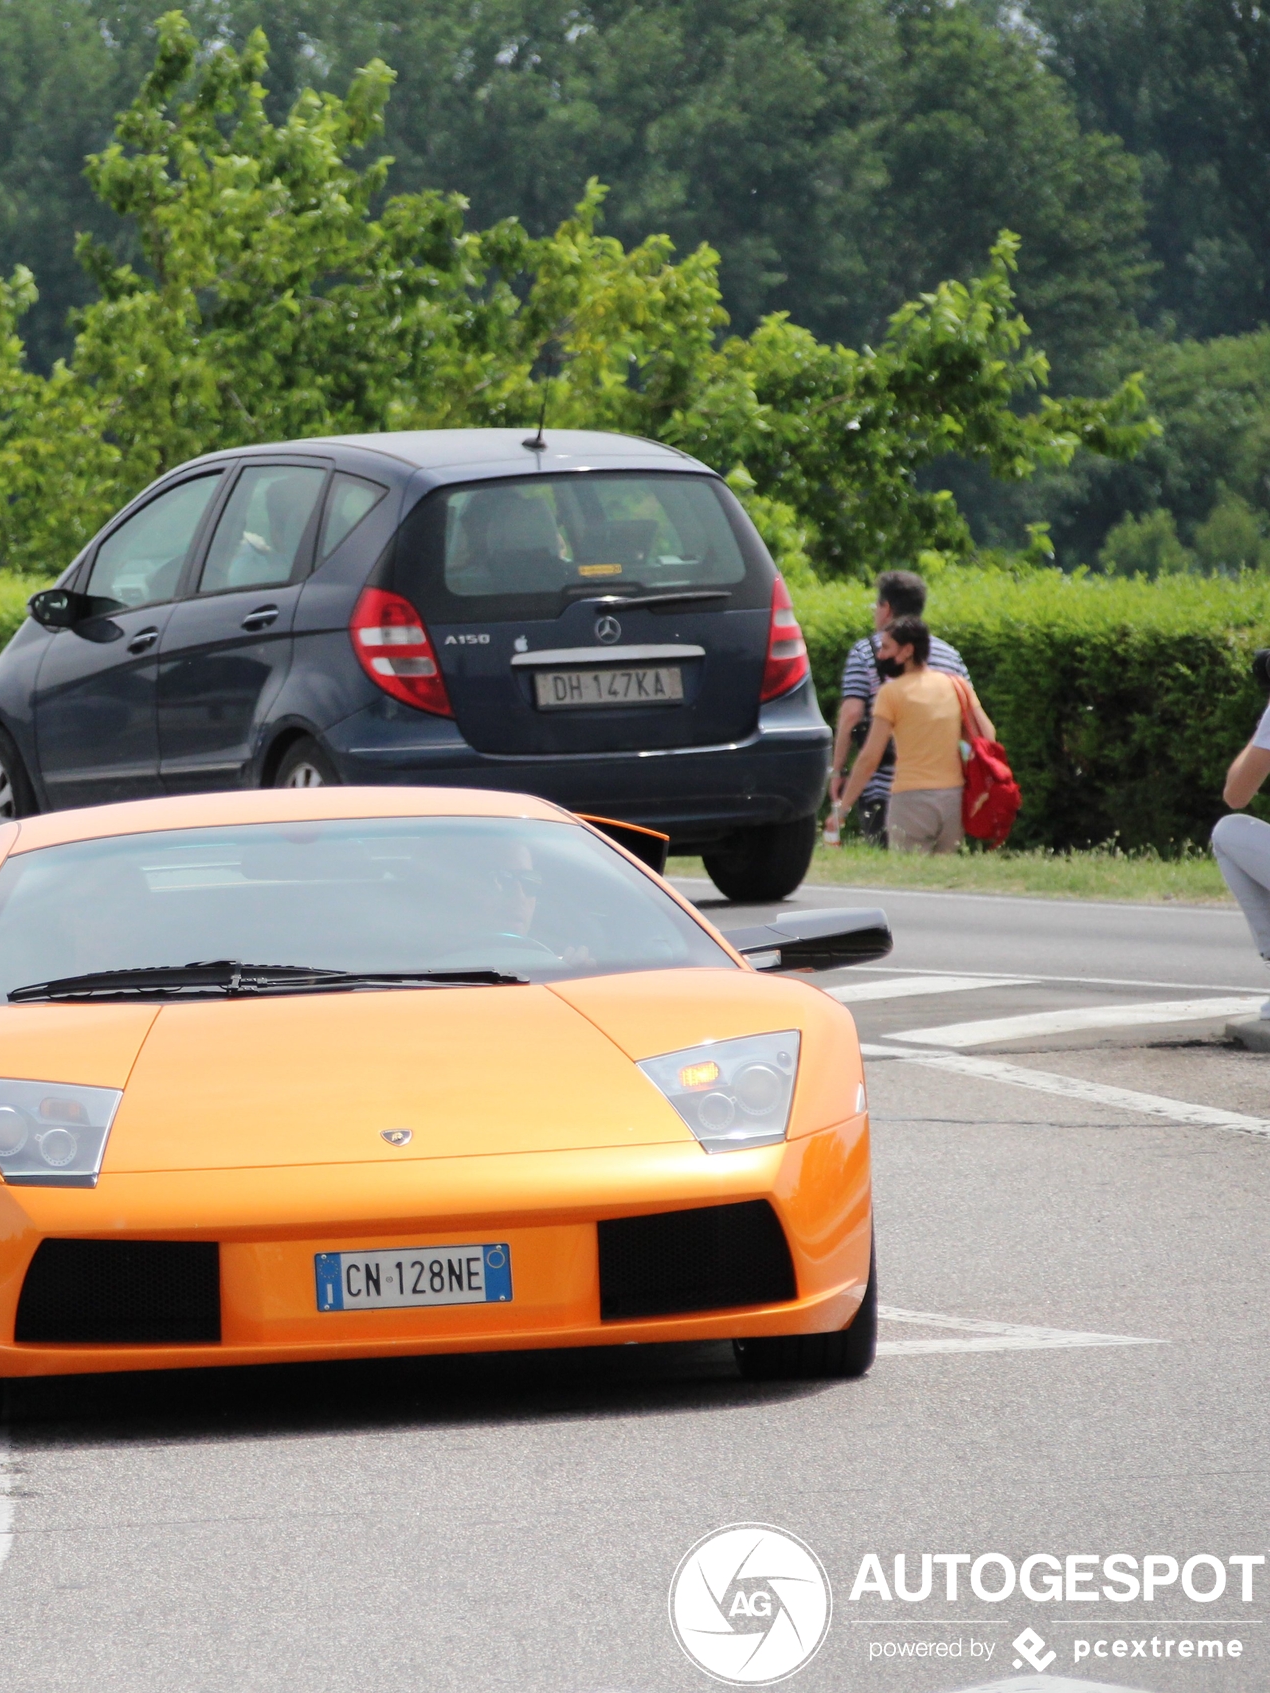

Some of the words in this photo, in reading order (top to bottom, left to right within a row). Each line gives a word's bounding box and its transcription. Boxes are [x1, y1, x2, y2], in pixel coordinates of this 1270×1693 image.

[444, 633, 491, 646] A150
[552, 675, 584, 702] DH
[592, 671, 667, 700] 147KA
[346, 1262, 382, 1298] CN
[395, 1257, 482, 1295] 128NE
